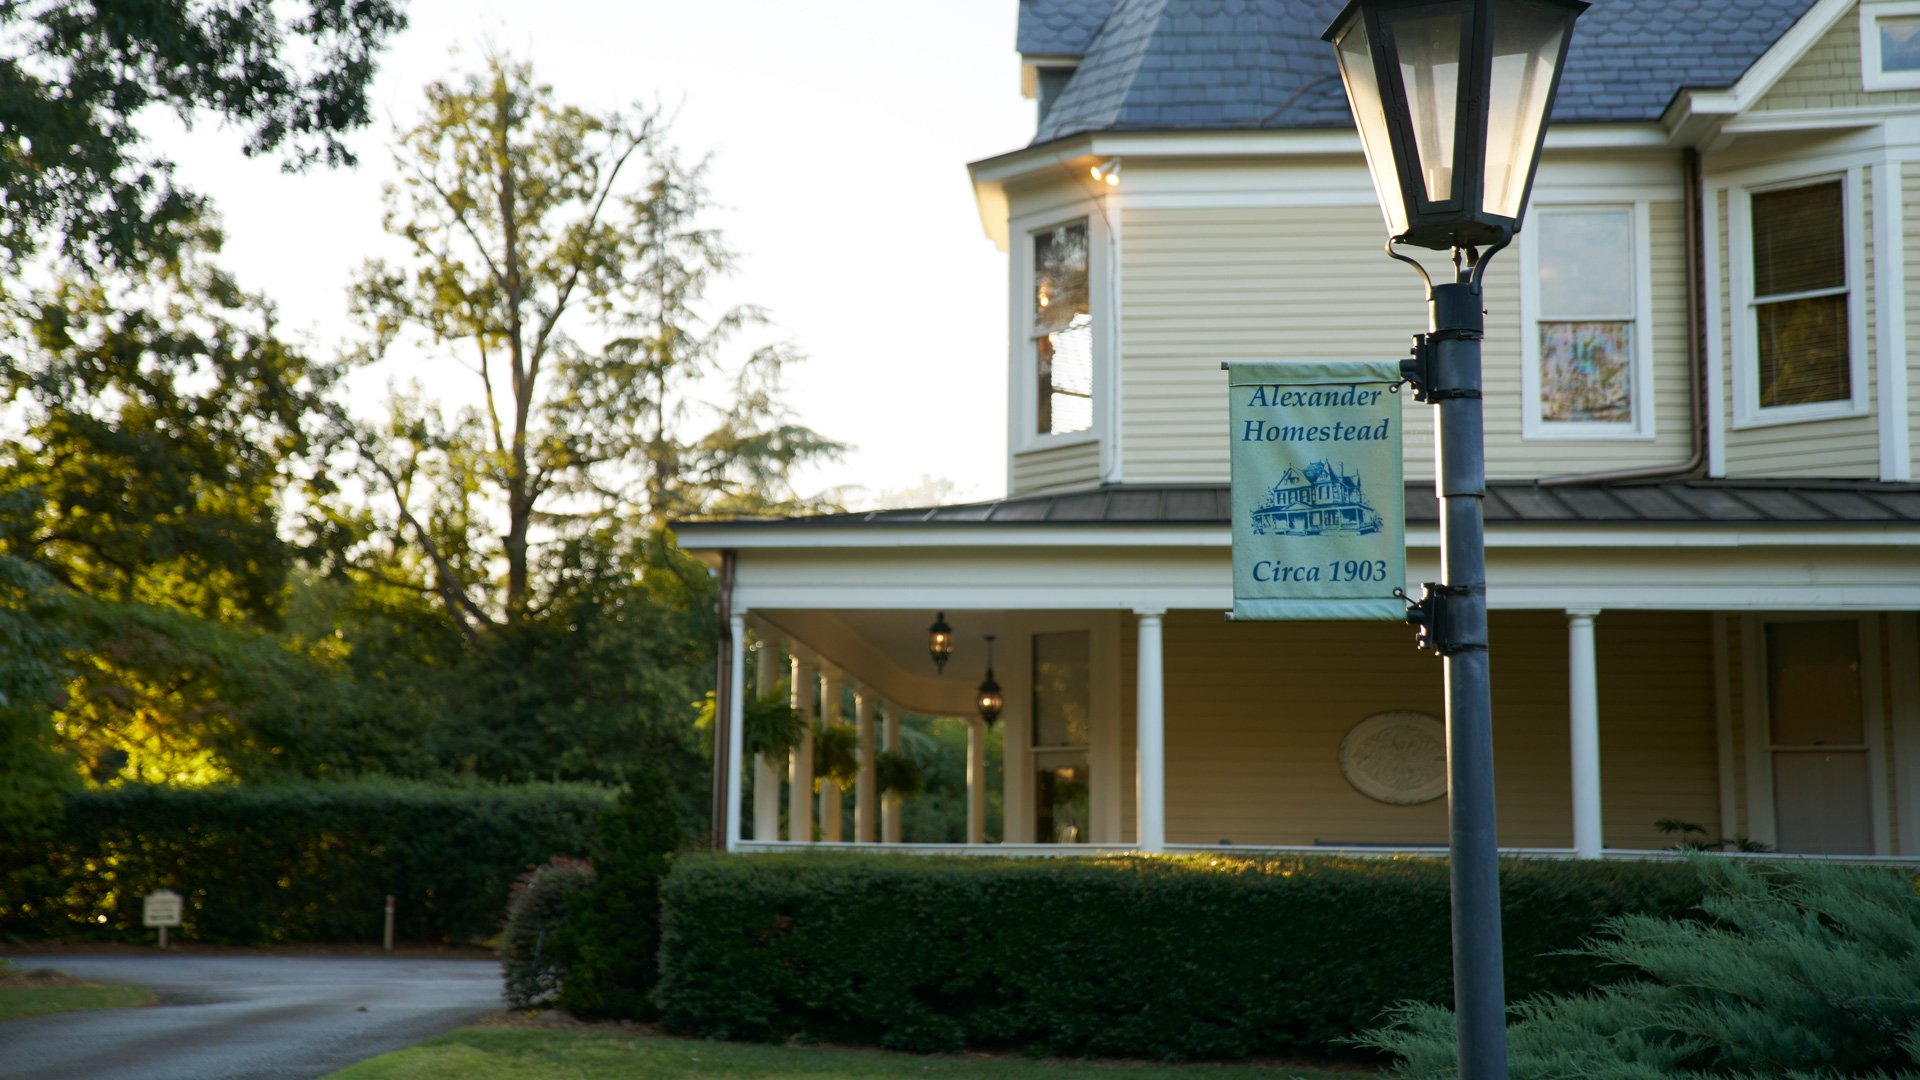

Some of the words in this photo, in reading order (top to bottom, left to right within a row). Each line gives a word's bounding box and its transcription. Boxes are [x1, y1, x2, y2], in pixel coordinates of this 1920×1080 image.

[1248, 384, 1382, 407] Alexander
[1242, 418, 1390, 442] Homestead
[1252, 560, 1320, 582] Circa
[1329, 560, 1387, 582] 1903
